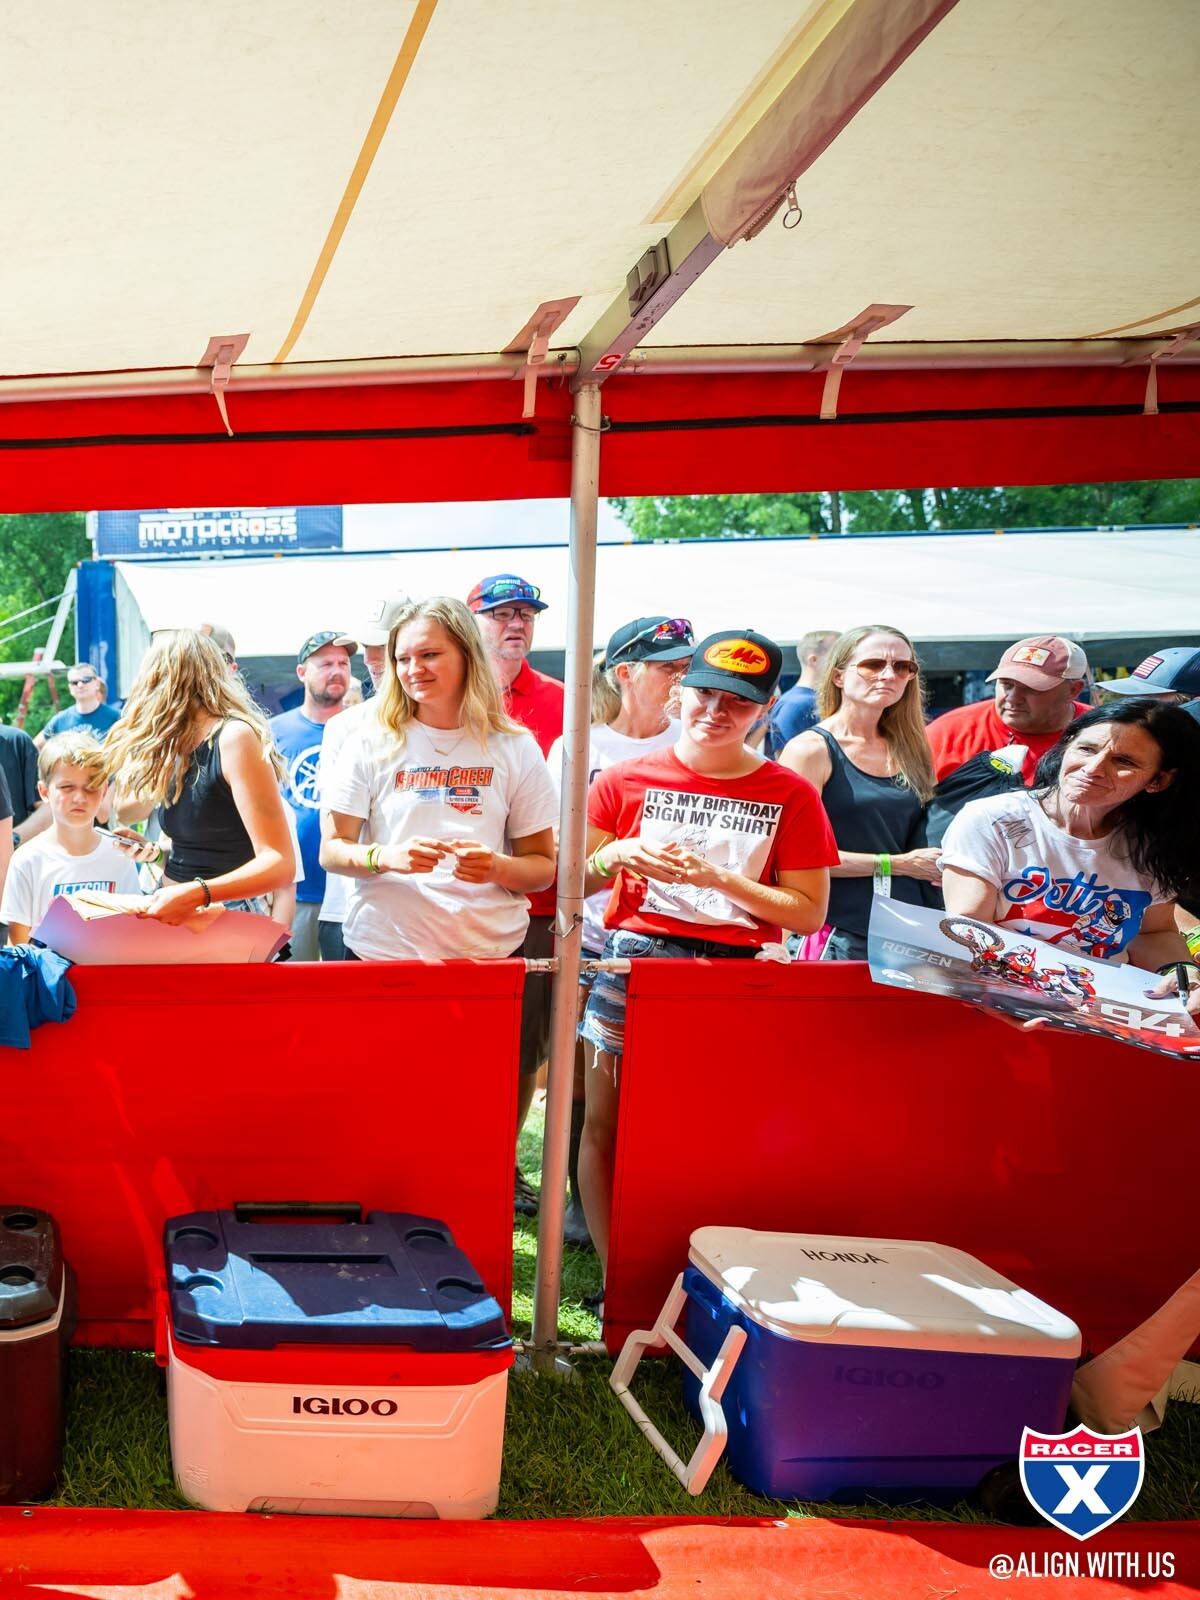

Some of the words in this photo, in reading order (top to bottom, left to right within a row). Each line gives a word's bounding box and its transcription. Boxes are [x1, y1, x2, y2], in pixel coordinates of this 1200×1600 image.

[138, 516, 298, 541] MOTOCROSS
[139, 536, 298, 548] CHAMPIONSHIP
[711, 647, 765, 664] FMF
[394, 769, 449, 792] SPRING
[448, 767, 494, 786] CREEK
[646, 790, 674, 805] IT'S
[677, 793, 701, 808] MY
[703, 796, 782, 820] BIRTHDAY
[643, 804, 686, 823] SIGN
[689, 810, 718, 828] MY
[719, 814, 777, 837] SHIRT
[1003, 866, 1110, 916] Jett
[880, 940, 953, 968] ROCZEN
[1101, 1003, 1185, 1037] 94
[800, 1248, 890, 1265] HONDA
[293, 1396, 398, 1416] IGLOO
